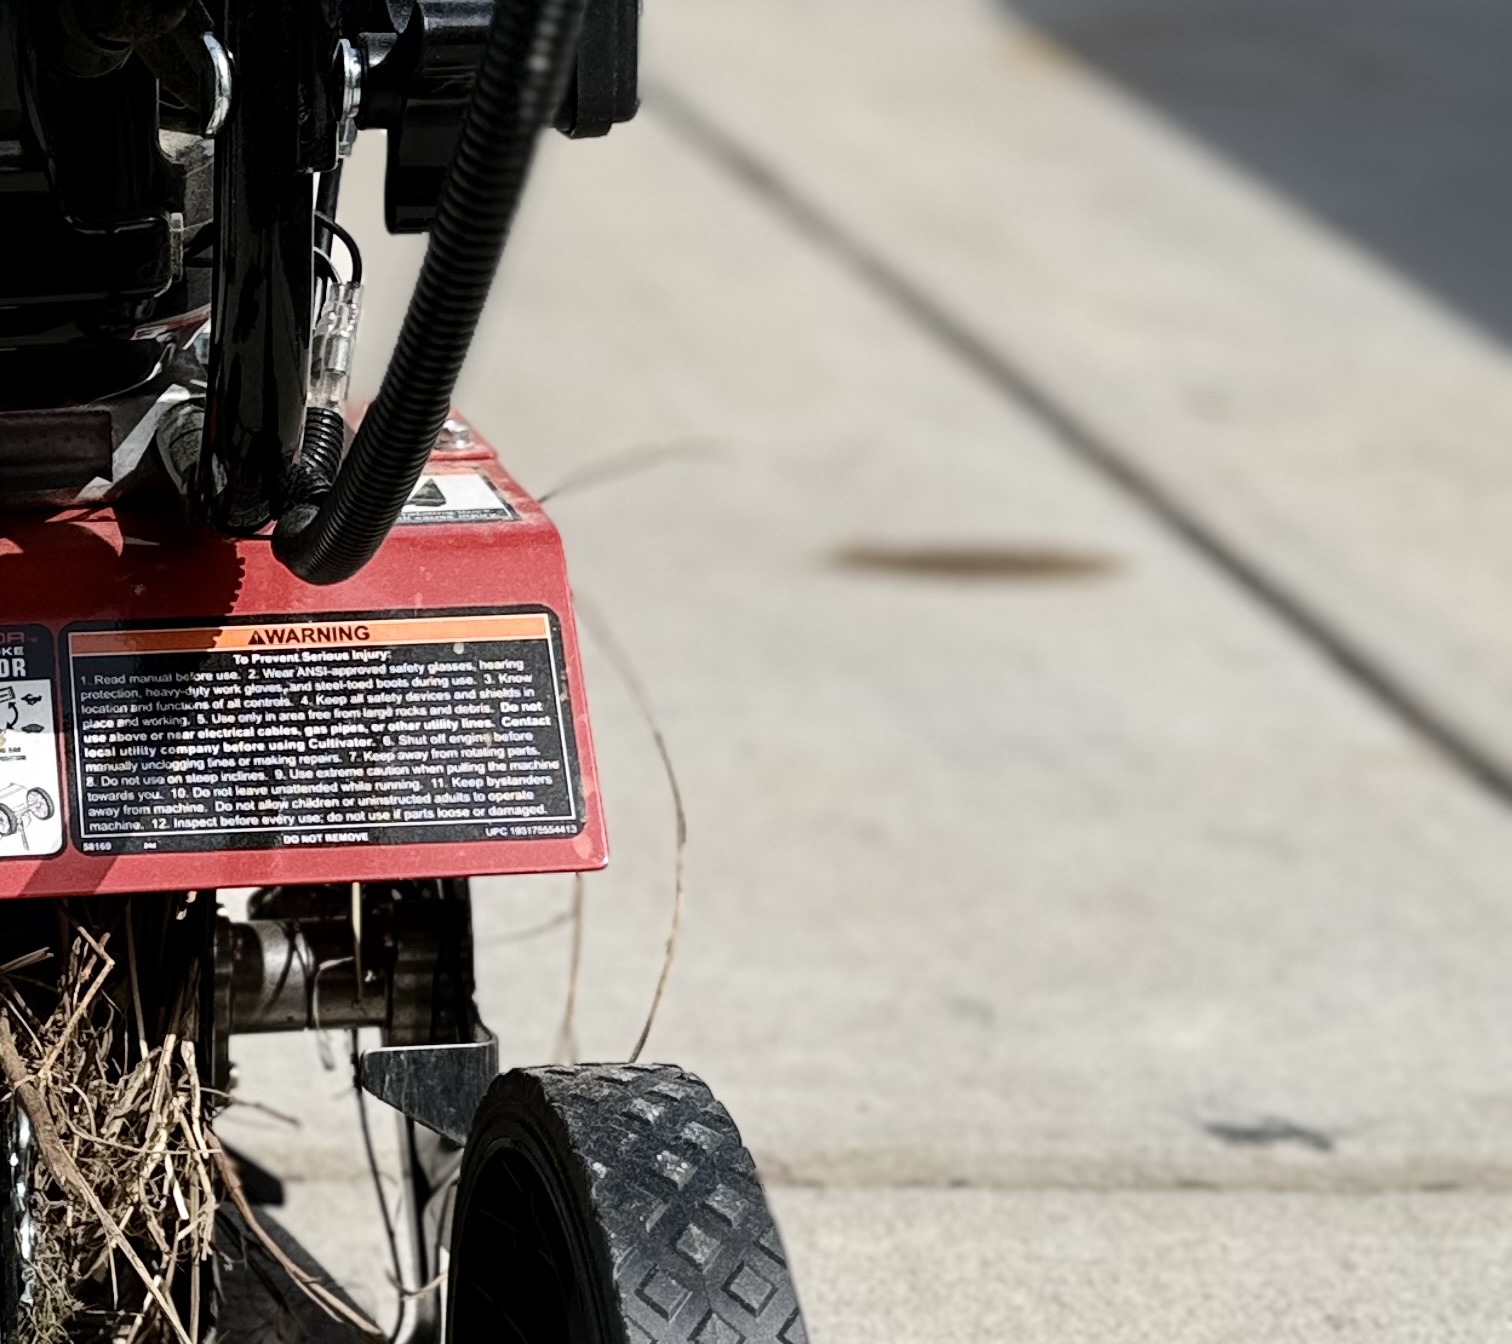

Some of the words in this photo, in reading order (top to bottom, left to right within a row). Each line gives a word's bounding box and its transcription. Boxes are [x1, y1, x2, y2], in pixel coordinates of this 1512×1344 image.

[265, 626, 370, 644] WARNING
[234, 653, 248, 664] To
[252, 651, 299, 664] Prevent
[302, 650, 348, 661] Serious
[129, 672, 172, 684] manual
[176, 671, 213, 682] before
[297, 663, 386, 679] ANSI-approved
[389, 662, 424, 676] safety
[479, 659, 524, 672] hearing
[146, 684, 210, 699] heavy-duty
[315, 678, 373, 691] steel-toed
[376, 677, 408, 689] boots
[412, 676, 448, 689] during
[81, 702, 127, 715] location
[156, 700, 209, 712] functions
[367, 692, 402, 705] safety
[406, 690, 451, 702] devices
[479, 687, 521, 699] shields
[83, 717, 114, 732] place
[363, 707, 391, 720] large
[396, 705, 427, 717] rocks
[109, 731, 147, 742] above
[167, 730, 194, 740] near
[198, 726, 254, 739] electrical
[388, 720, 420, 732] other
[424, 718, 458, 732] utility
[501, 715, 551, 728] Contact
[85, 745, 115, 757] local
[120, 744, 156, 757] utility
[161, 743, 219, 756] company
[223, 740, 264, 752] before
[269, 739, 305, 752] using
[399, 733, 428, 745] Shut
[449, 732, 491, 746] engine
[494, 730, 533, 742] before
[86, 760, 137, 773] manually
[141, 757, 204, 772] unclogging
[253, 754, 296, 767] making
[364, 751, 394, 764] Keep
[397, 750, 428, 762] away
[431, 748, 458, 759] from
[461, 746, 504, 759] rotating
[186, 772, 218, 785] steep
[316, 767, 363, 778] extreme
[367, 764, 409, 776] caution
[412, 763, 444, 775] when
[447, 761, 485, 776] pulling
[510, 759, 559, 771] machine
[88, 789, 134, 802] towards
[236, 785, 267, 796] leave
[271, 781, 338, 795] unattended
[341, 780, 371, 792] while
[452, 777, 484, 790] Keep
[487, 774, 552, 789] bystanders
[88, 807, 119, 819] away
[123, 804, 150, 815] from
[291, 797, 339, 809] children
[358, 792, 430, 806] uninstructed
[434, 791, 470, 803] adults
[489, 789, 534, 803] operate
[174, 816, 217, 830] Inspect
[220, 815, 258, 827] before
[262, 815, 294, 827] every
[405, 808, 434, 822] parts
[437, 807, 470, 818] loose
[284, 834, 299, 844] DO
[301, 834, 322, 844] NOT
[325, 832, 369, 842] REMOVE
[485, 827, 508, 837] UPC
